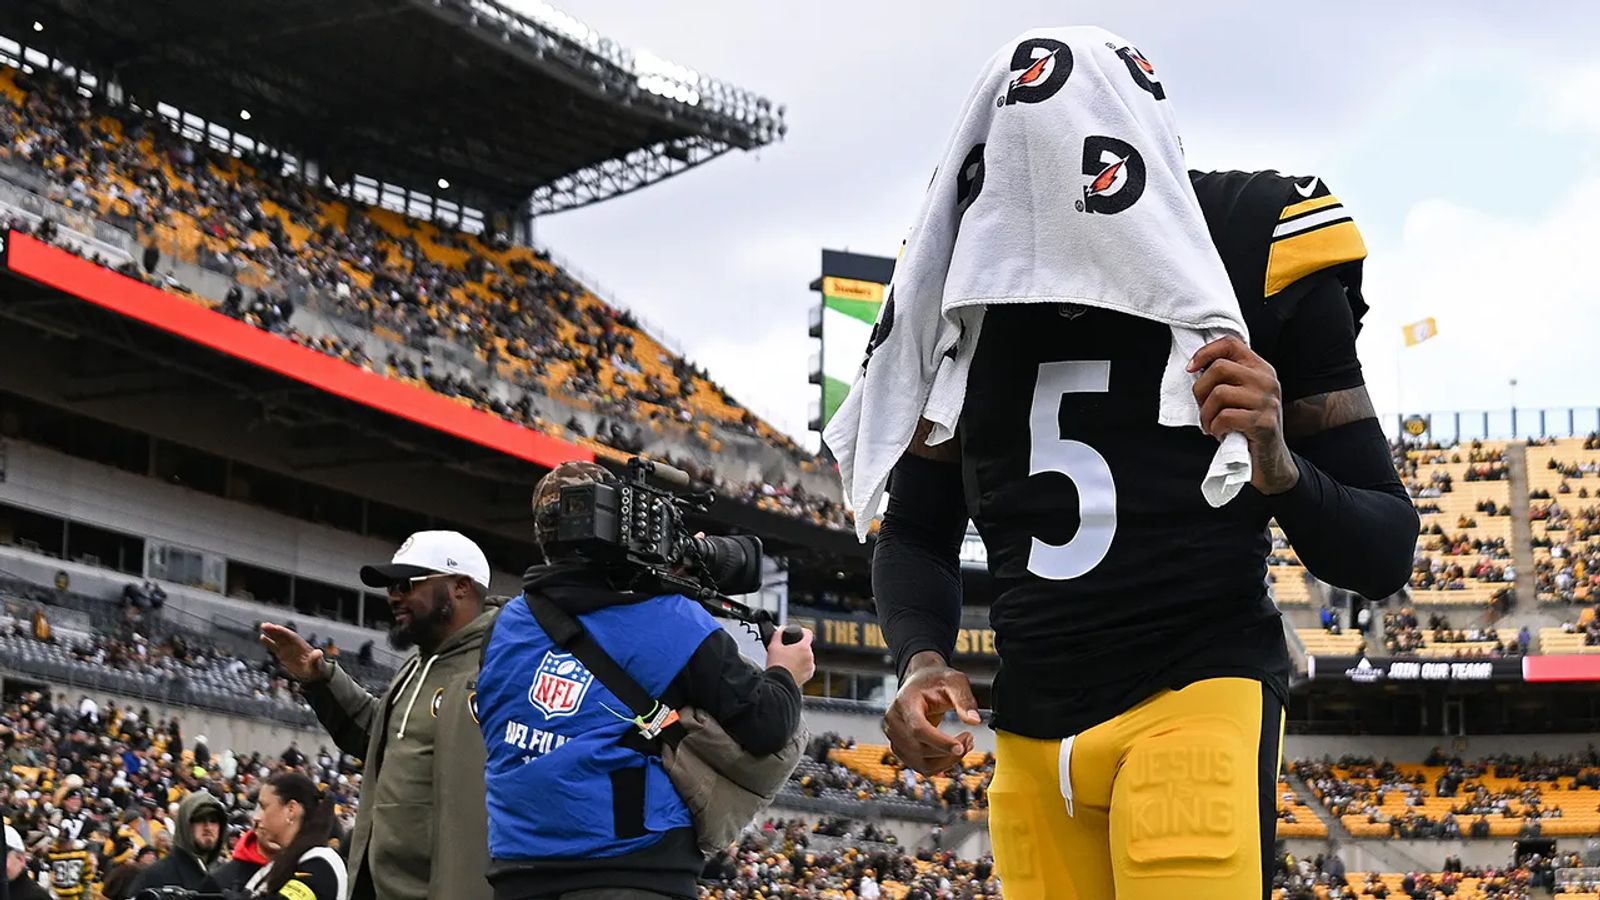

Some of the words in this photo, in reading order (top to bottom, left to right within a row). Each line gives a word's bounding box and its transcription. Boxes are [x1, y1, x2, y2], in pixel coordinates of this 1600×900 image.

[1026, 360, 1118, 580] 5
[824, 619, 859, 645] THE
[1387, 662, 1420, 679] JOIN
[1421, 662, 1450, 679] OUR
[535, 675, 576, 710] NFL
[504, 720, 529, 749] NFL
[1130, 747, 1234, 788] JESUS
[1130, 797, 1234, 841] KING
